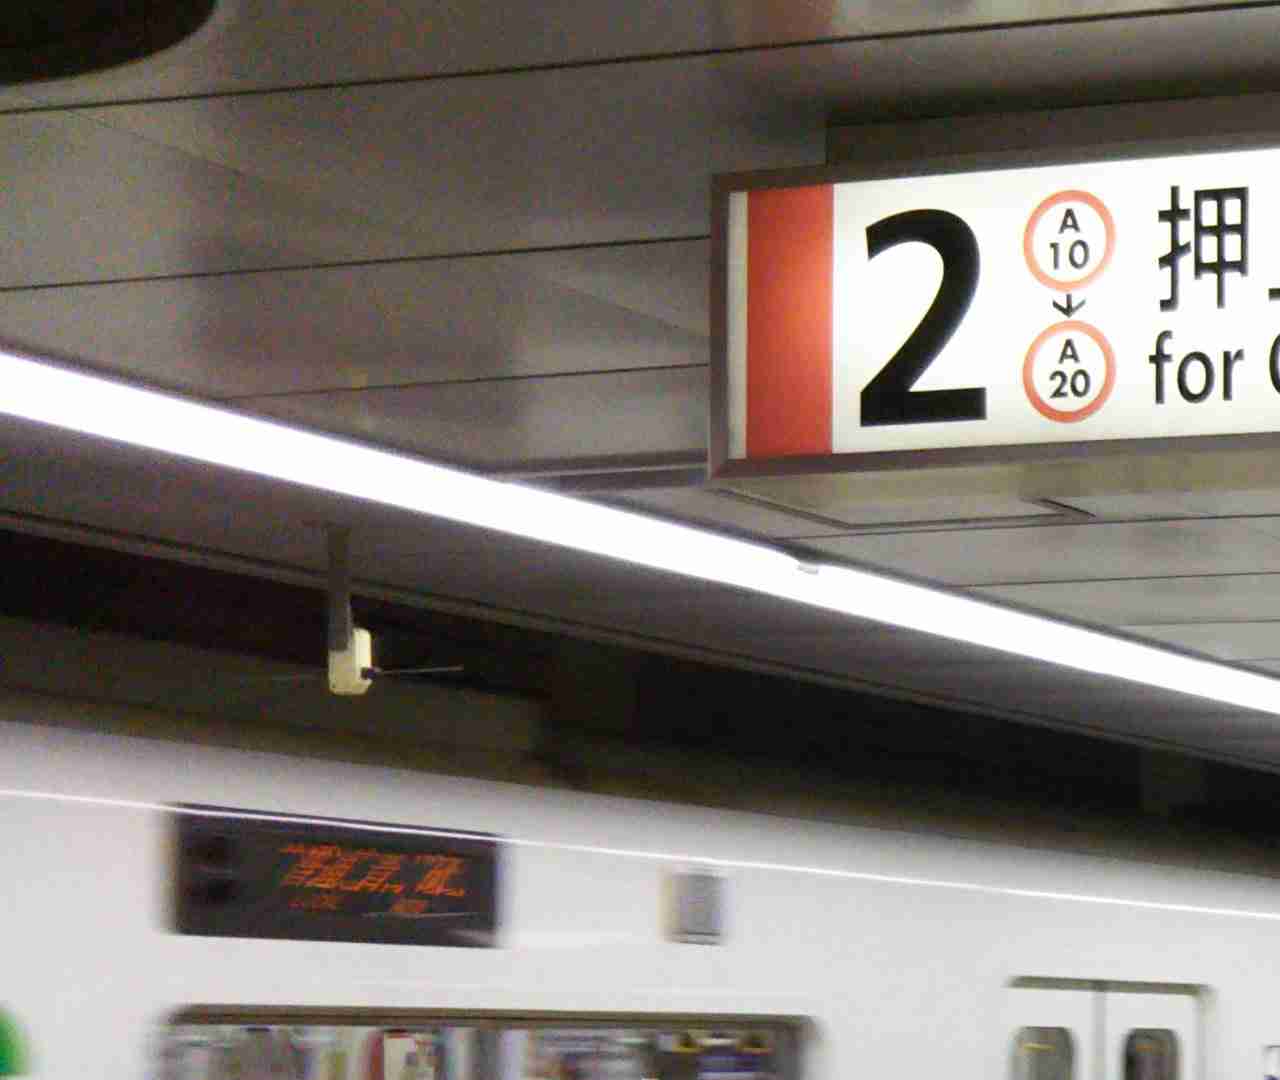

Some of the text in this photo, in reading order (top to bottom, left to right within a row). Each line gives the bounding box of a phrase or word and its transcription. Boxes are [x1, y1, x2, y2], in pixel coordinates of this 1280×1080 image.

[1057, 208, 1080, 233] A
[1048, 239, 1089, 269] 10
[858, 207, 988, 429] 2
[1057, 339, 1080, 364] A
[1147, 329, 1244, 405] for
[1048, 369, 1091, 398] 20
